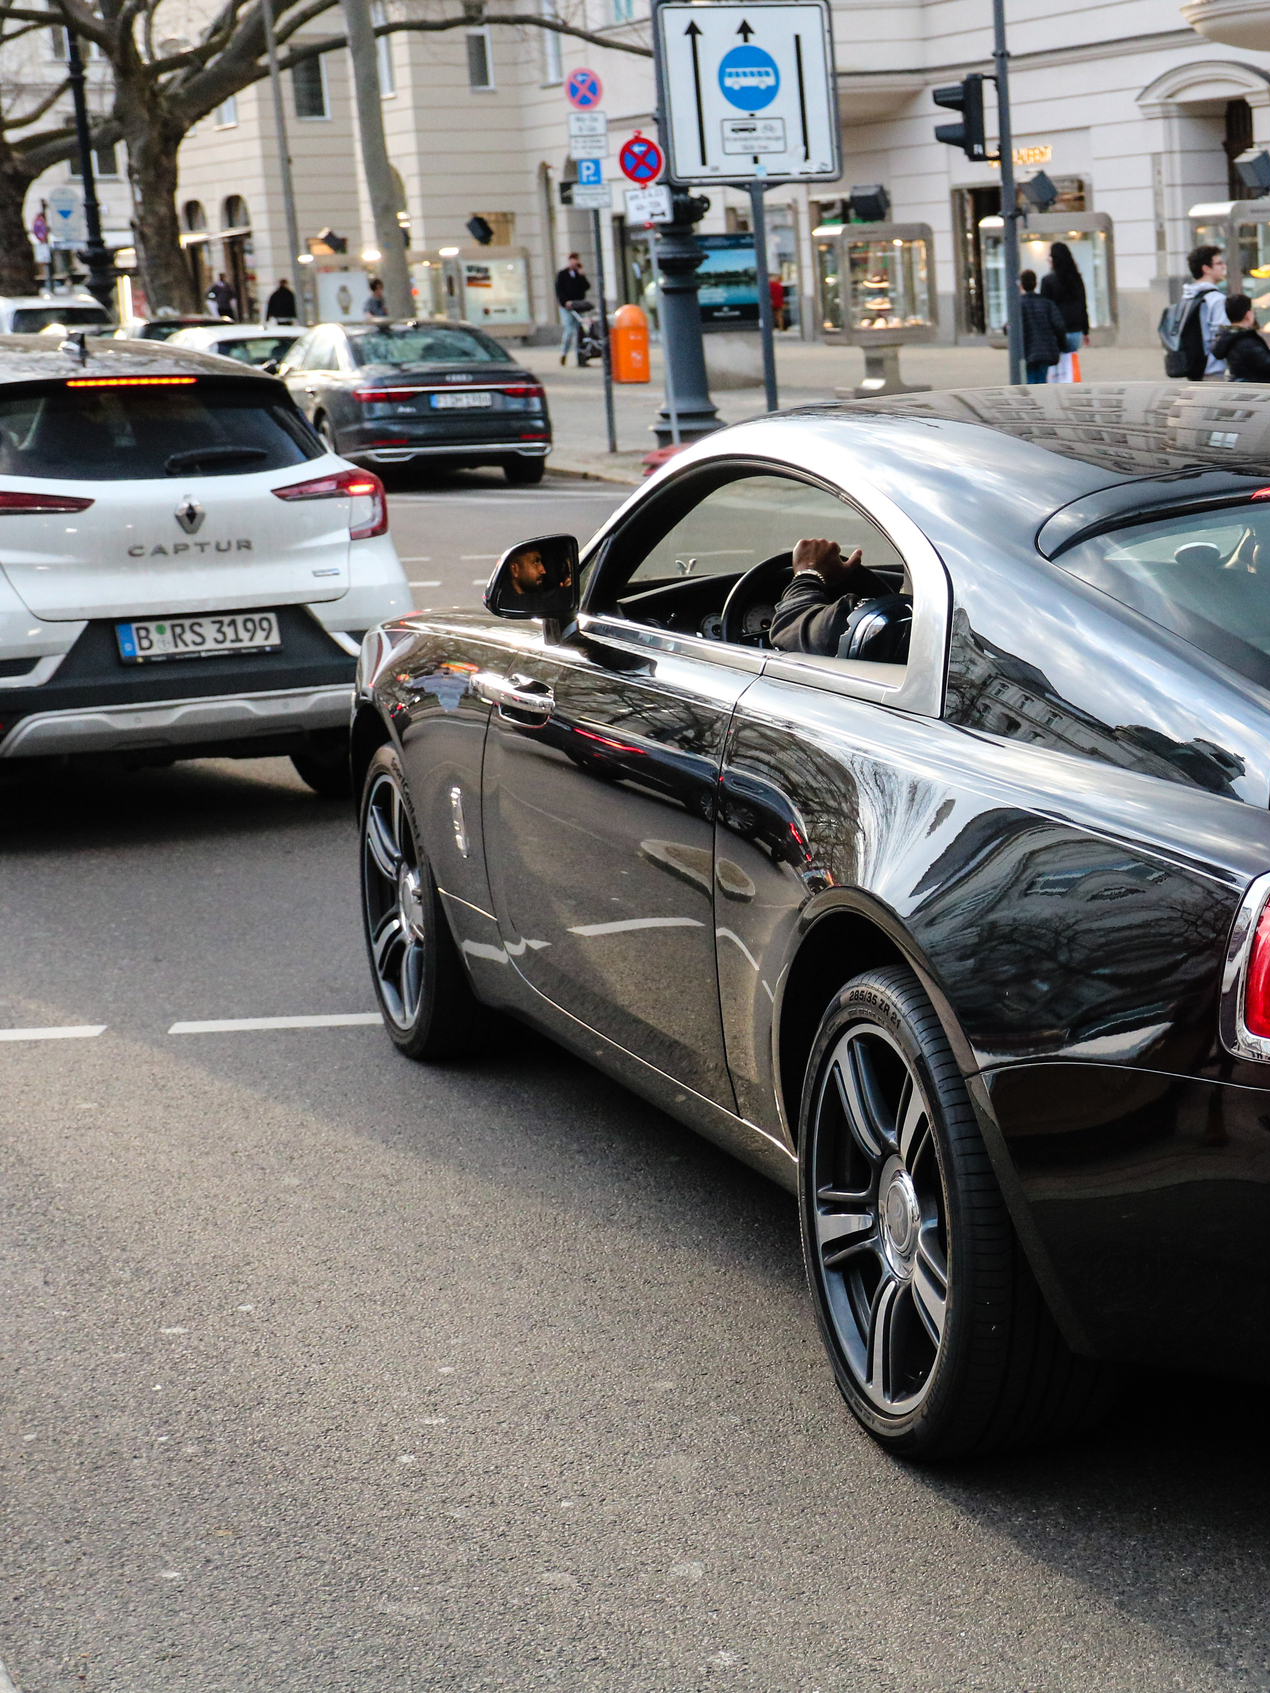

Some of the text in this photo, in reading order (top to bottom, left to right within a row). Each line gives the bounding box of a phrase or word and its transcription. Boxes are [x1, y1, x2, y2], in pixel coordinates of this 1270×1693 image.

[127, 538, 253, 558] CAPTUR
[135, 616, 273, 651] B RS 3199
[849, 989, 902, 1030] 285/35 ZR 21
